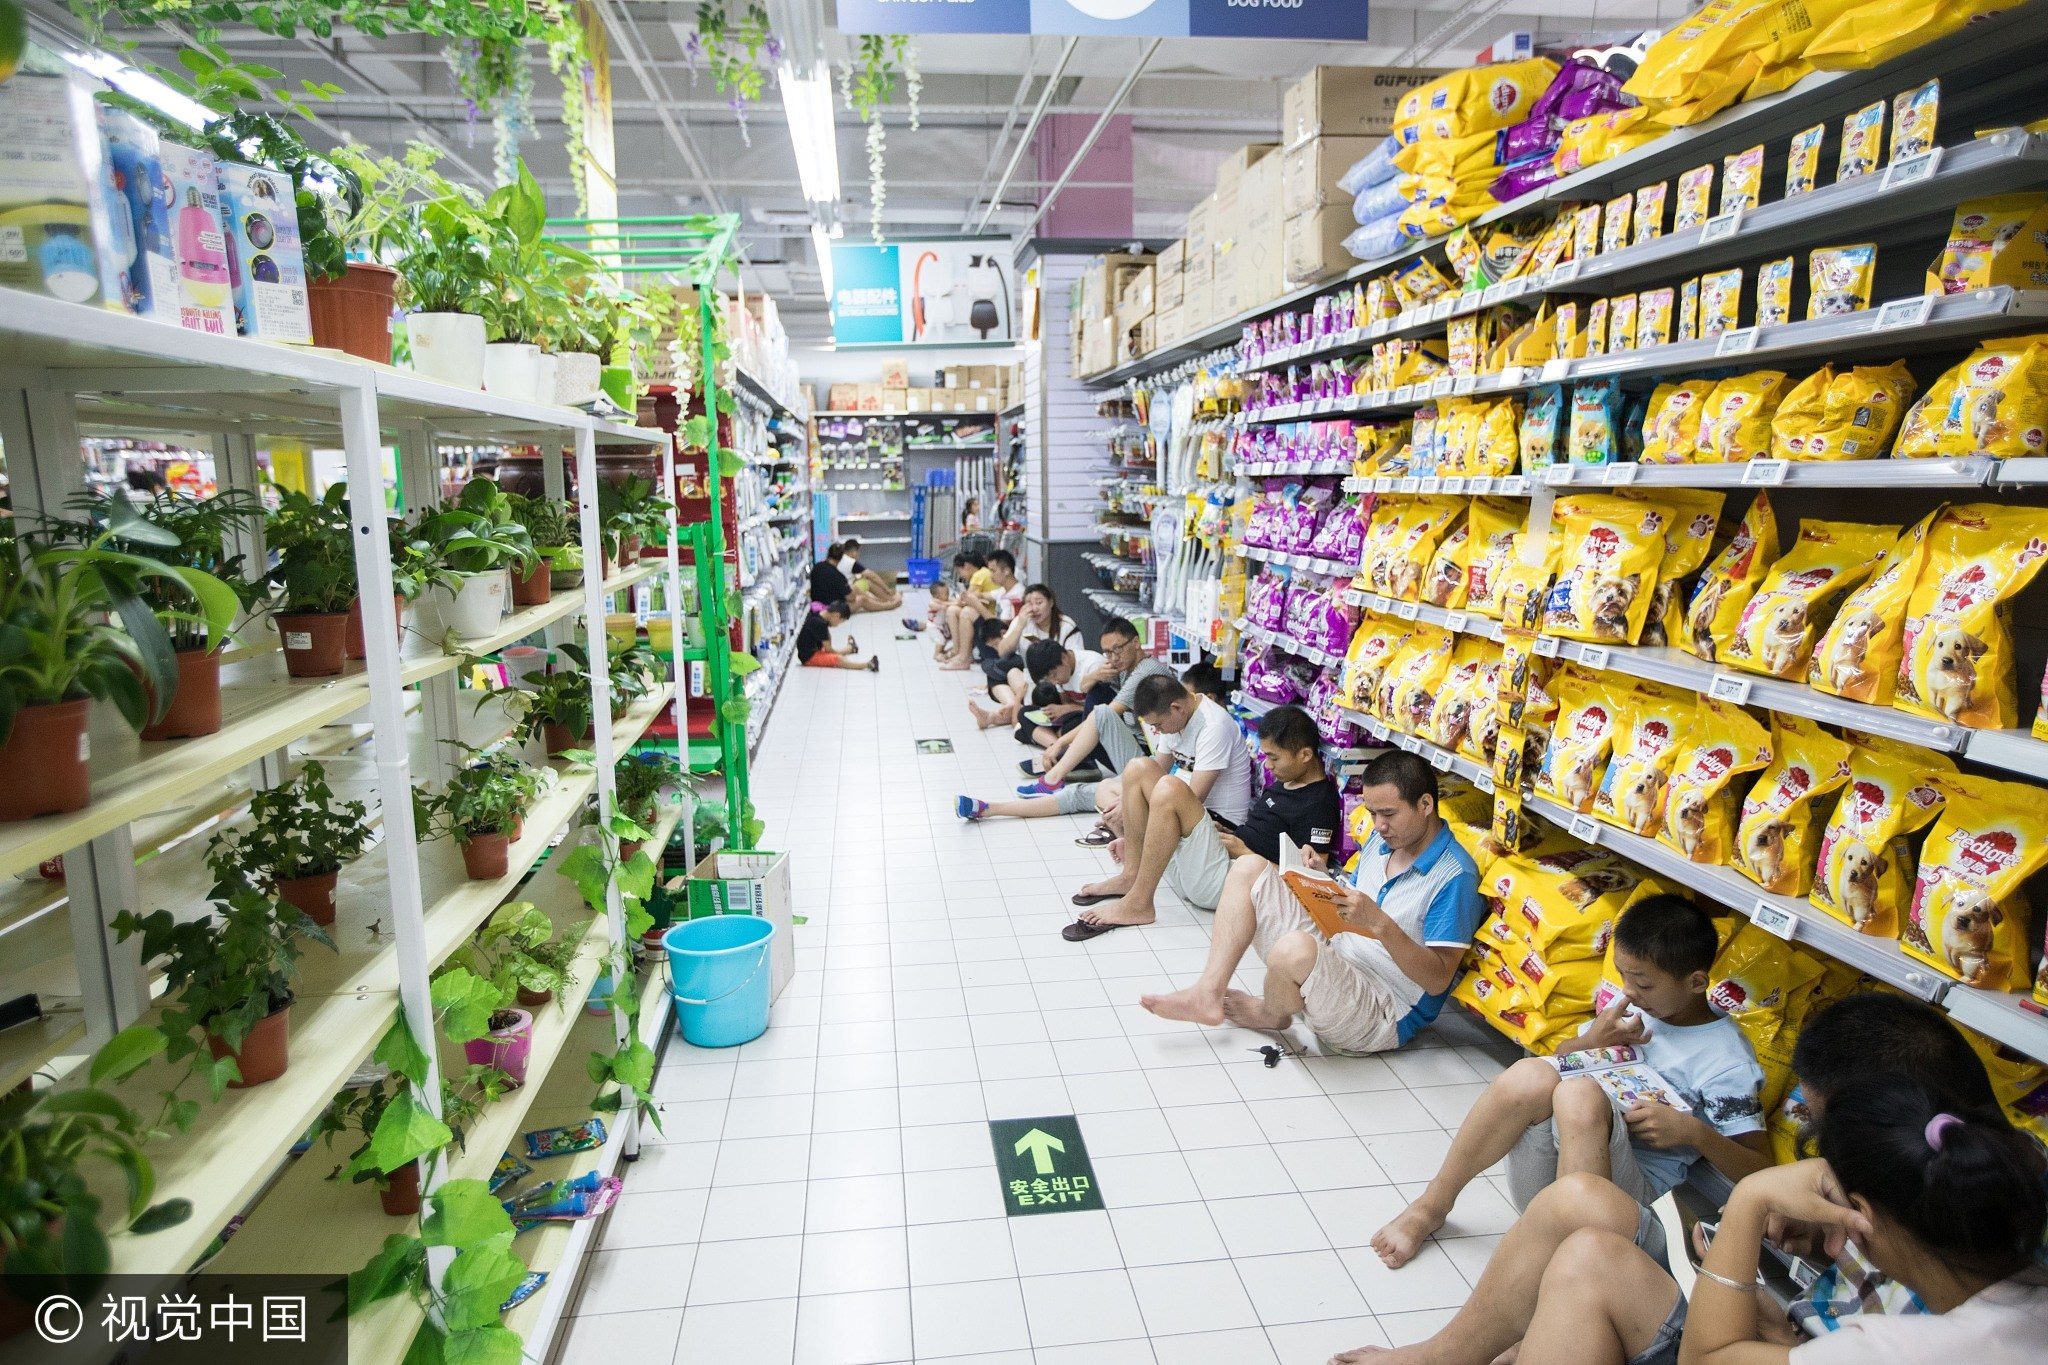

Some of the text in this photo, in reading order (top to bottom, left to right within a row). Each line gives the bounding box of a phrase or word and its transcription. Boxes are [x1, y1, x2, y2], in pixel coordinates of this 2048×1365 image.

[1750, 801, 1767, 815] 5
[1831, 824, 1846, 843] 5
[1945, 827, 2023, 867] Pedigree
[1009, 1176, 1090, 1195] 安全出口
[1018, 1191, 1086, 1206] EXIT
